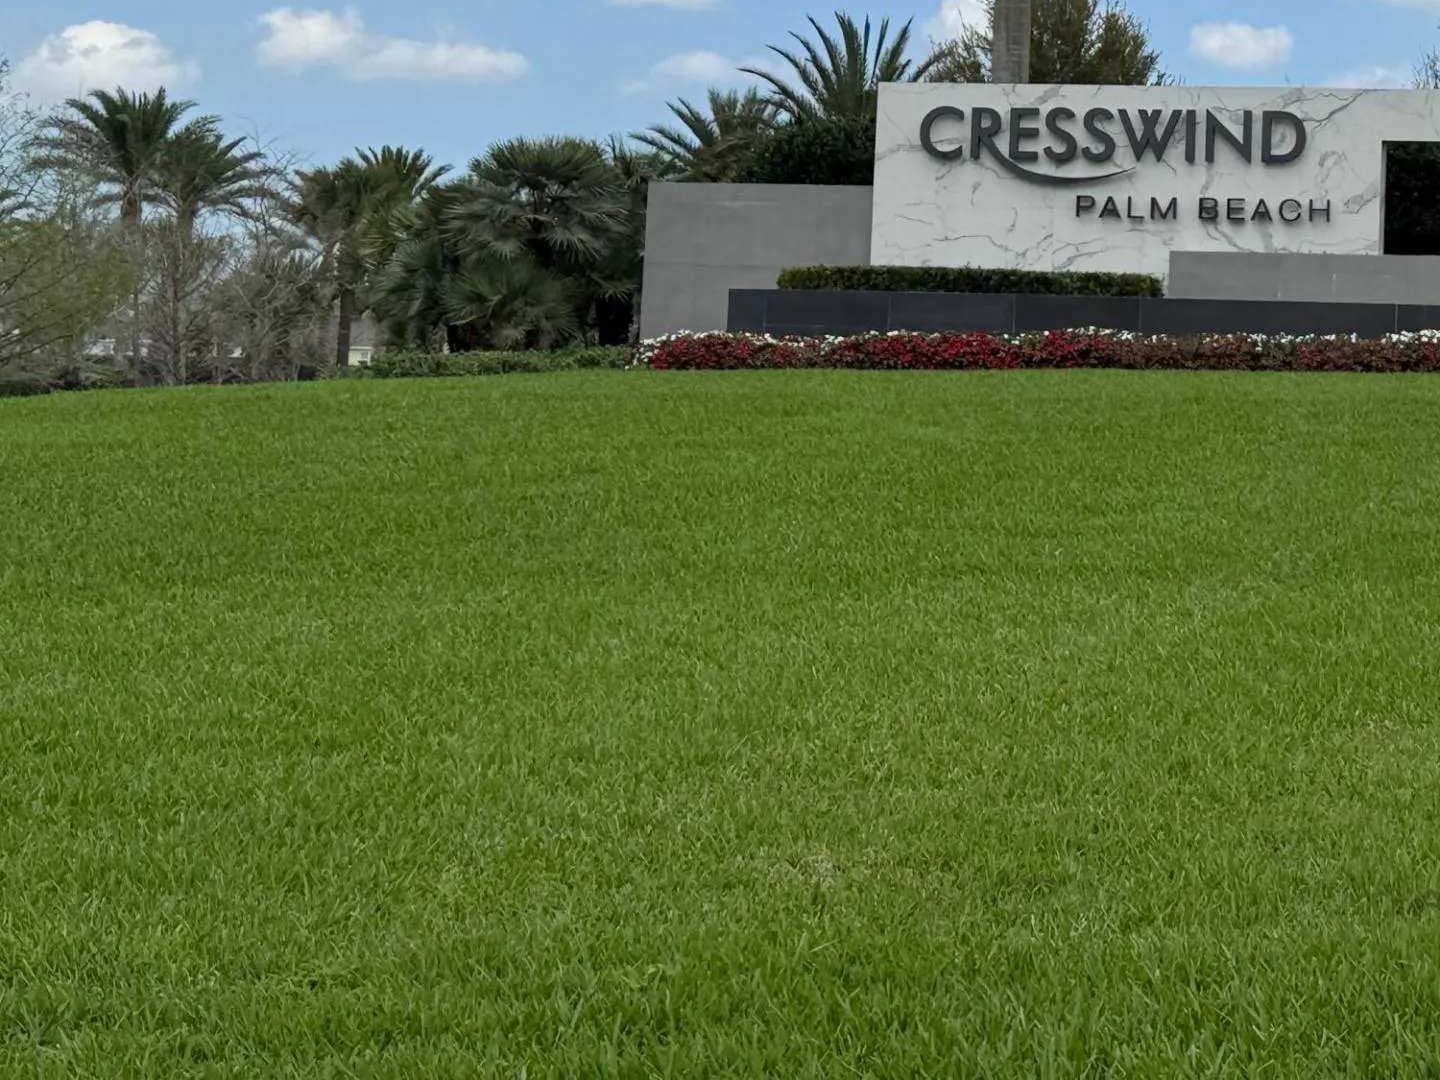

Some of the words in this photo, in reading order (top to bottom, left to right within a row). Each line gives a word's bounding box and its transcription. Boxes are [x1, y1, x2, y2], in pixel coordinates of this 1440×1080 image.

[920, 105, 1307, 184] CRESSWIND
[1075, 195, 1177, 220] PALM
[1198, 197, 1331, 223] BEACH
